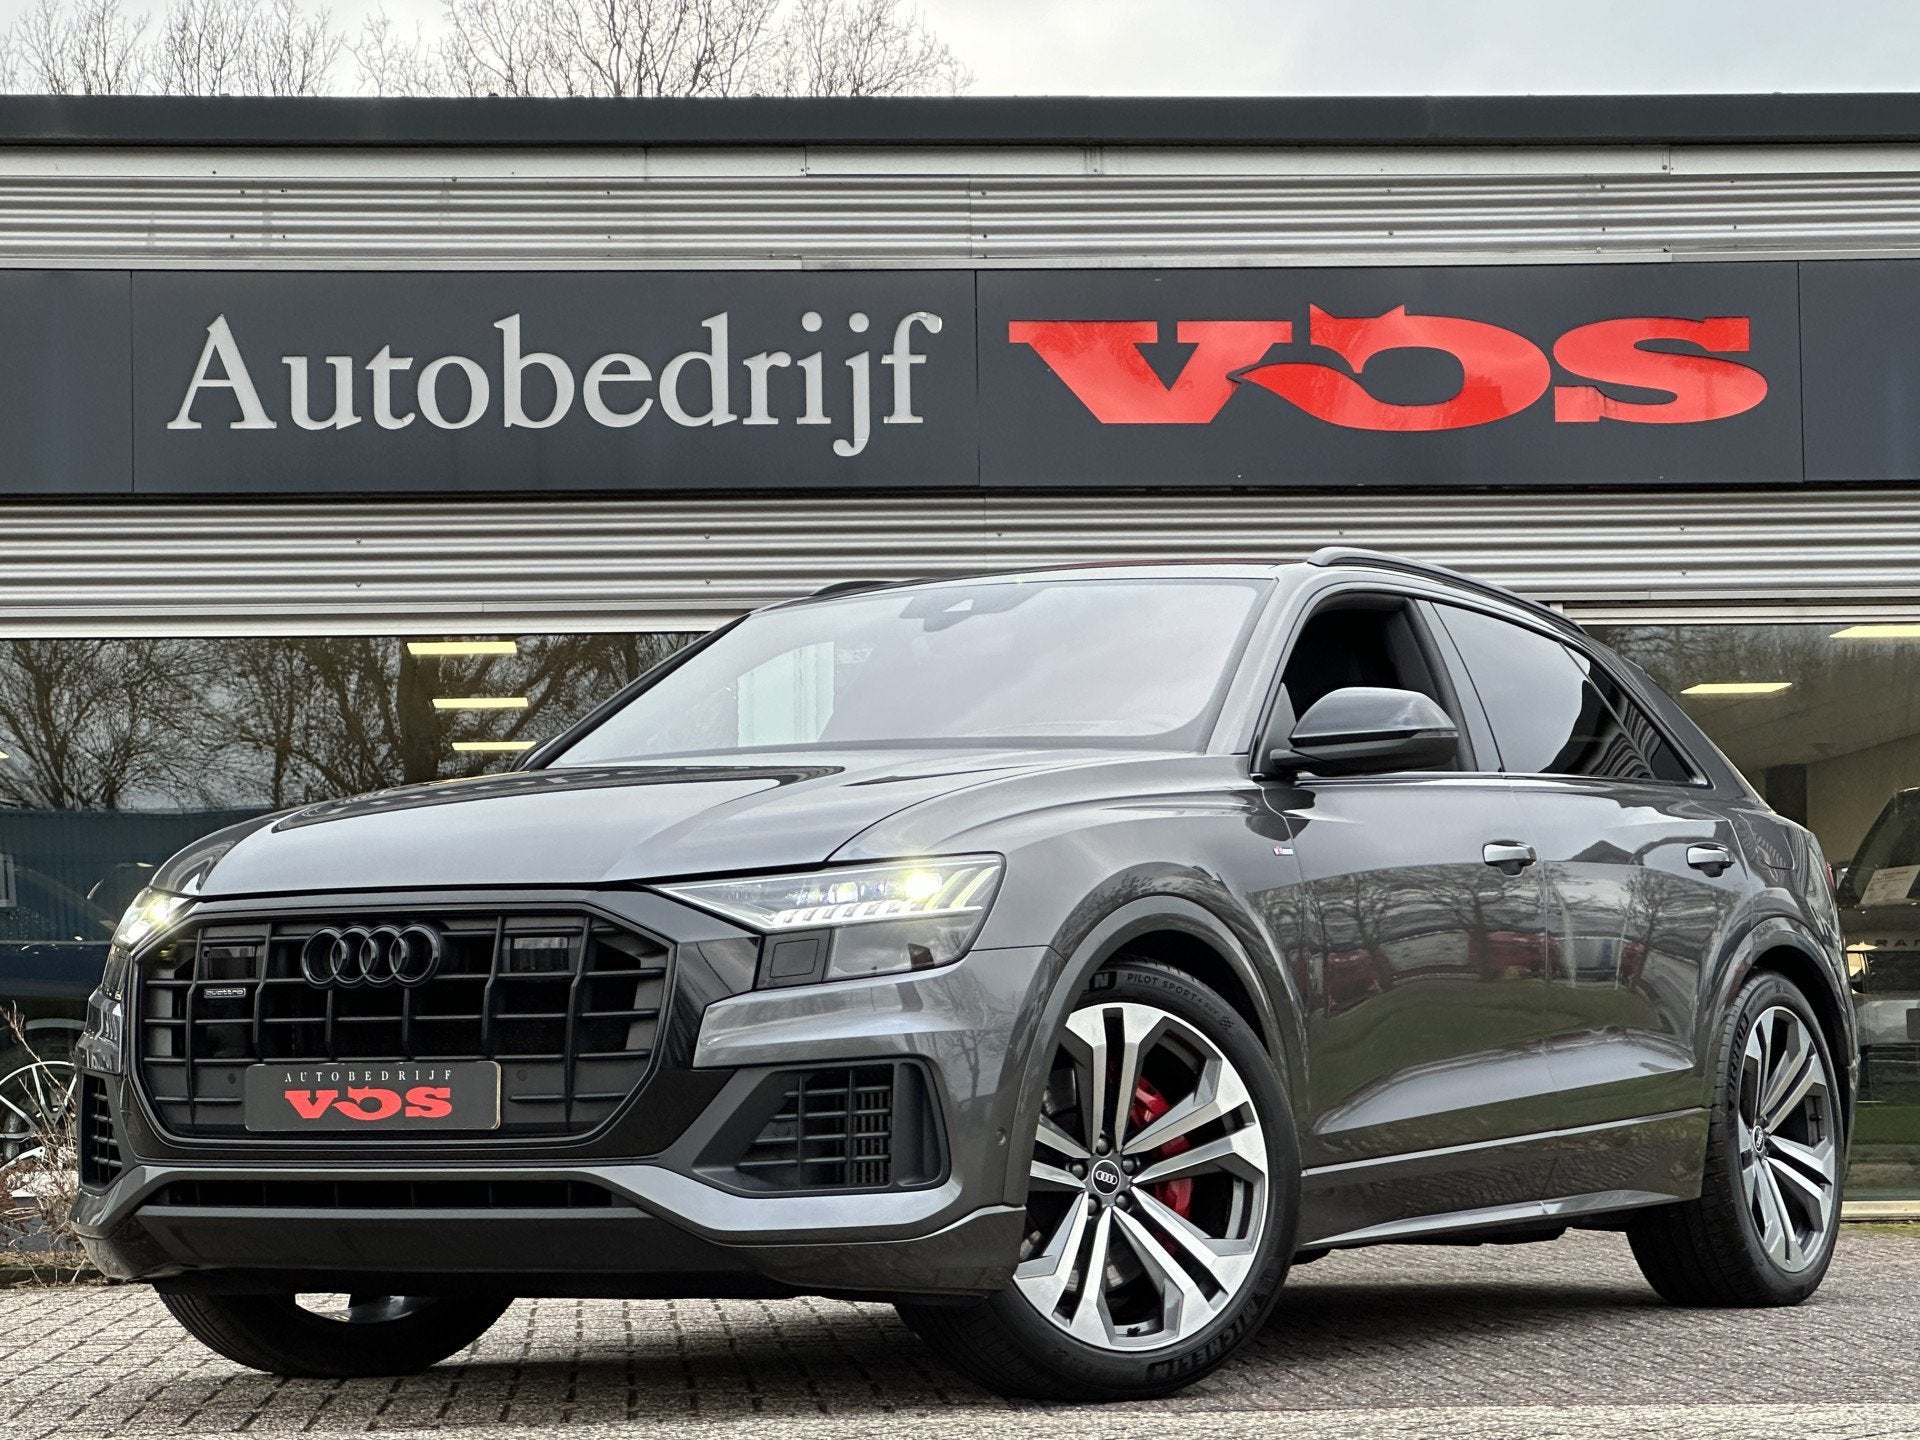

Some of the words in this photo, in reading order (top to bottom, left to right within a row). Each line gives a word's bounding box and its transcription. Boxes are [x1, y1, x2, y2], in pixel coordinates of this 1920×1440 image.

[166, 310, 943, 457] Autobedrijf
[1008, 303, 1769, 431] VOS
[1127, 973, 1159, 986] PILOT
[1161, 980, 1198, 1001] SPORT
[285, 1070, 452, 1083] AUTOBEDRIJF
[284, 1086, 453, 1121] VOS
[1152, 1300, 1262, 1380] MICHELIN
